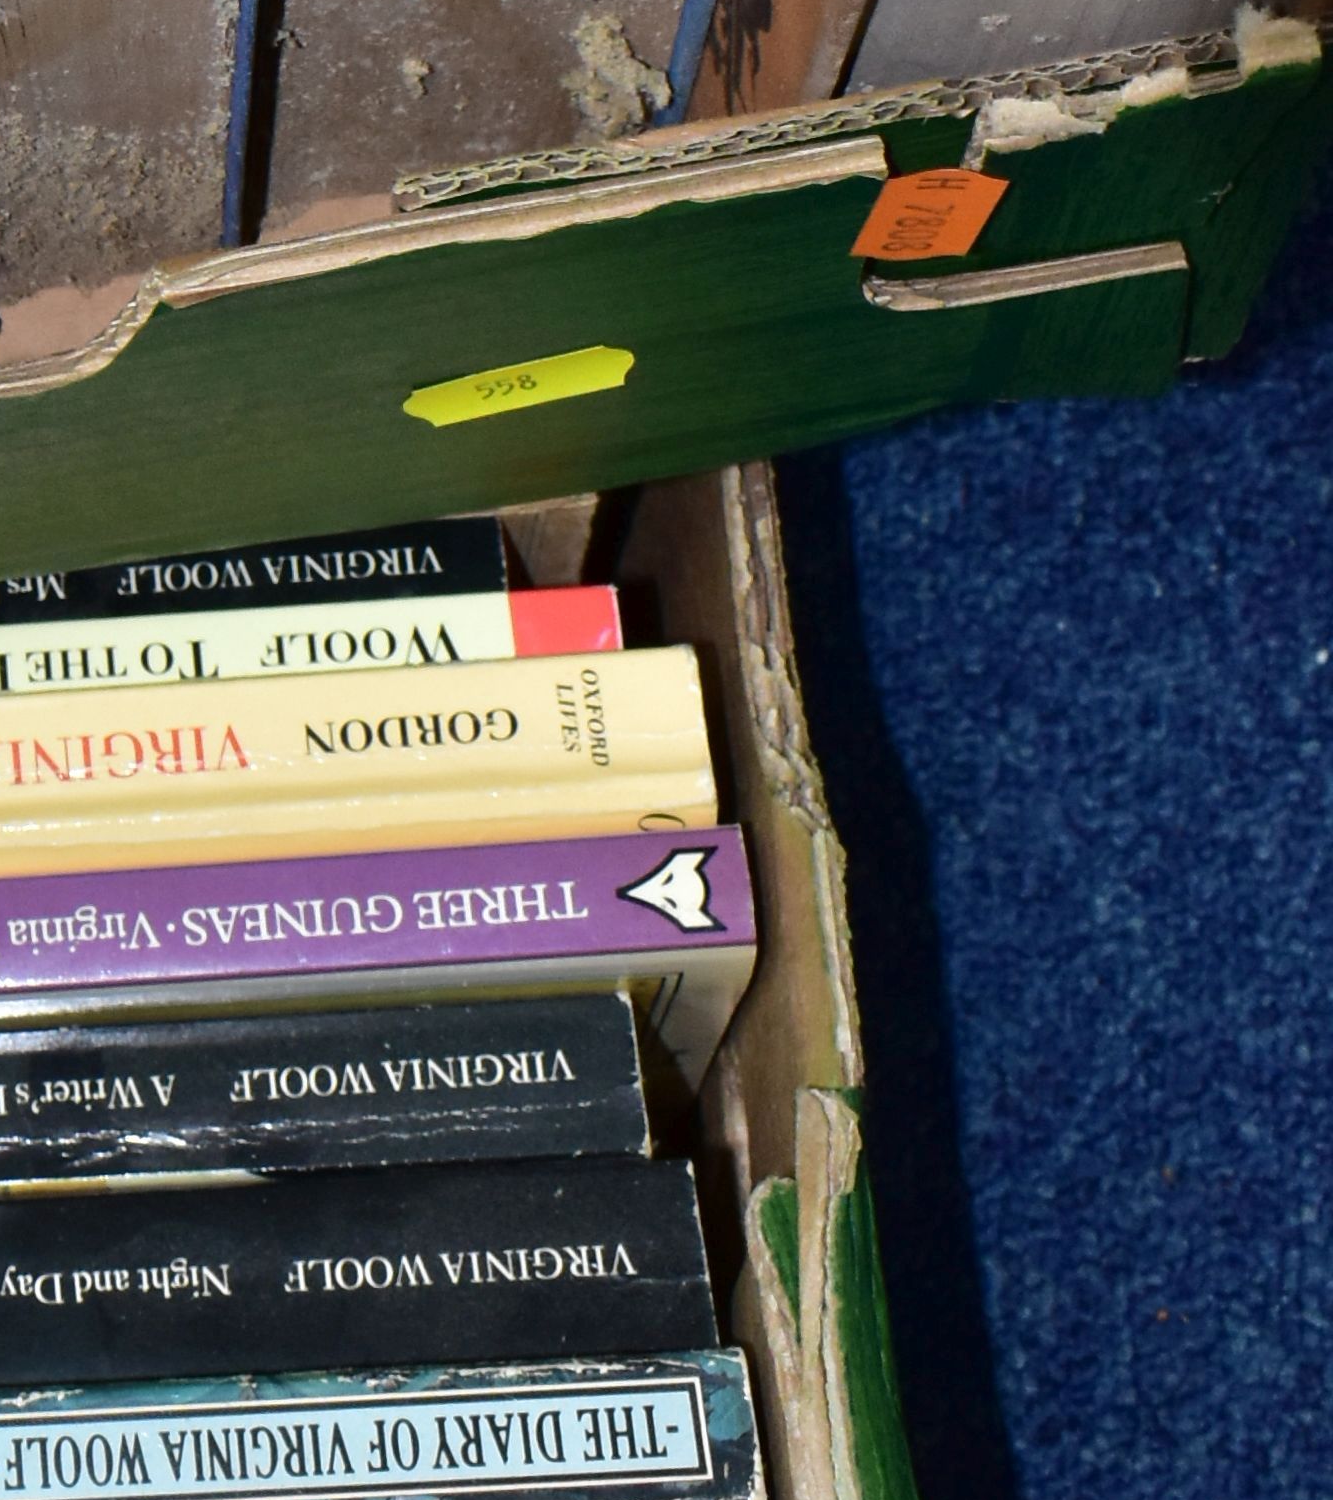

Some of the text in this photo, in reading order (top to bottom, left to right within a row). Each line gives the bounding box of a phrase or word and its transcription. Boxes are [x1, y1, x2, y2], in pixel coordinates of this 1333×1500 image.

[475, 372, 538, 402] 558
[302, 706, 522, 758] GORDON
[412, 880, 590, 932] THREE
[149, 1072, 178, 1107] A
[228, 1060, 376, 1103] WOOLF
[382, 1047, 576, 1092] VIRGINIA
[14, 1076, 145, 1115] Writer's
[71, 1265, 130, 1297] and
[135, 1256, 232, 1300] Night
[281, 1251, 434, 1294] WOOLF
[439, 1241, 637, 1284] VIRGINIA
